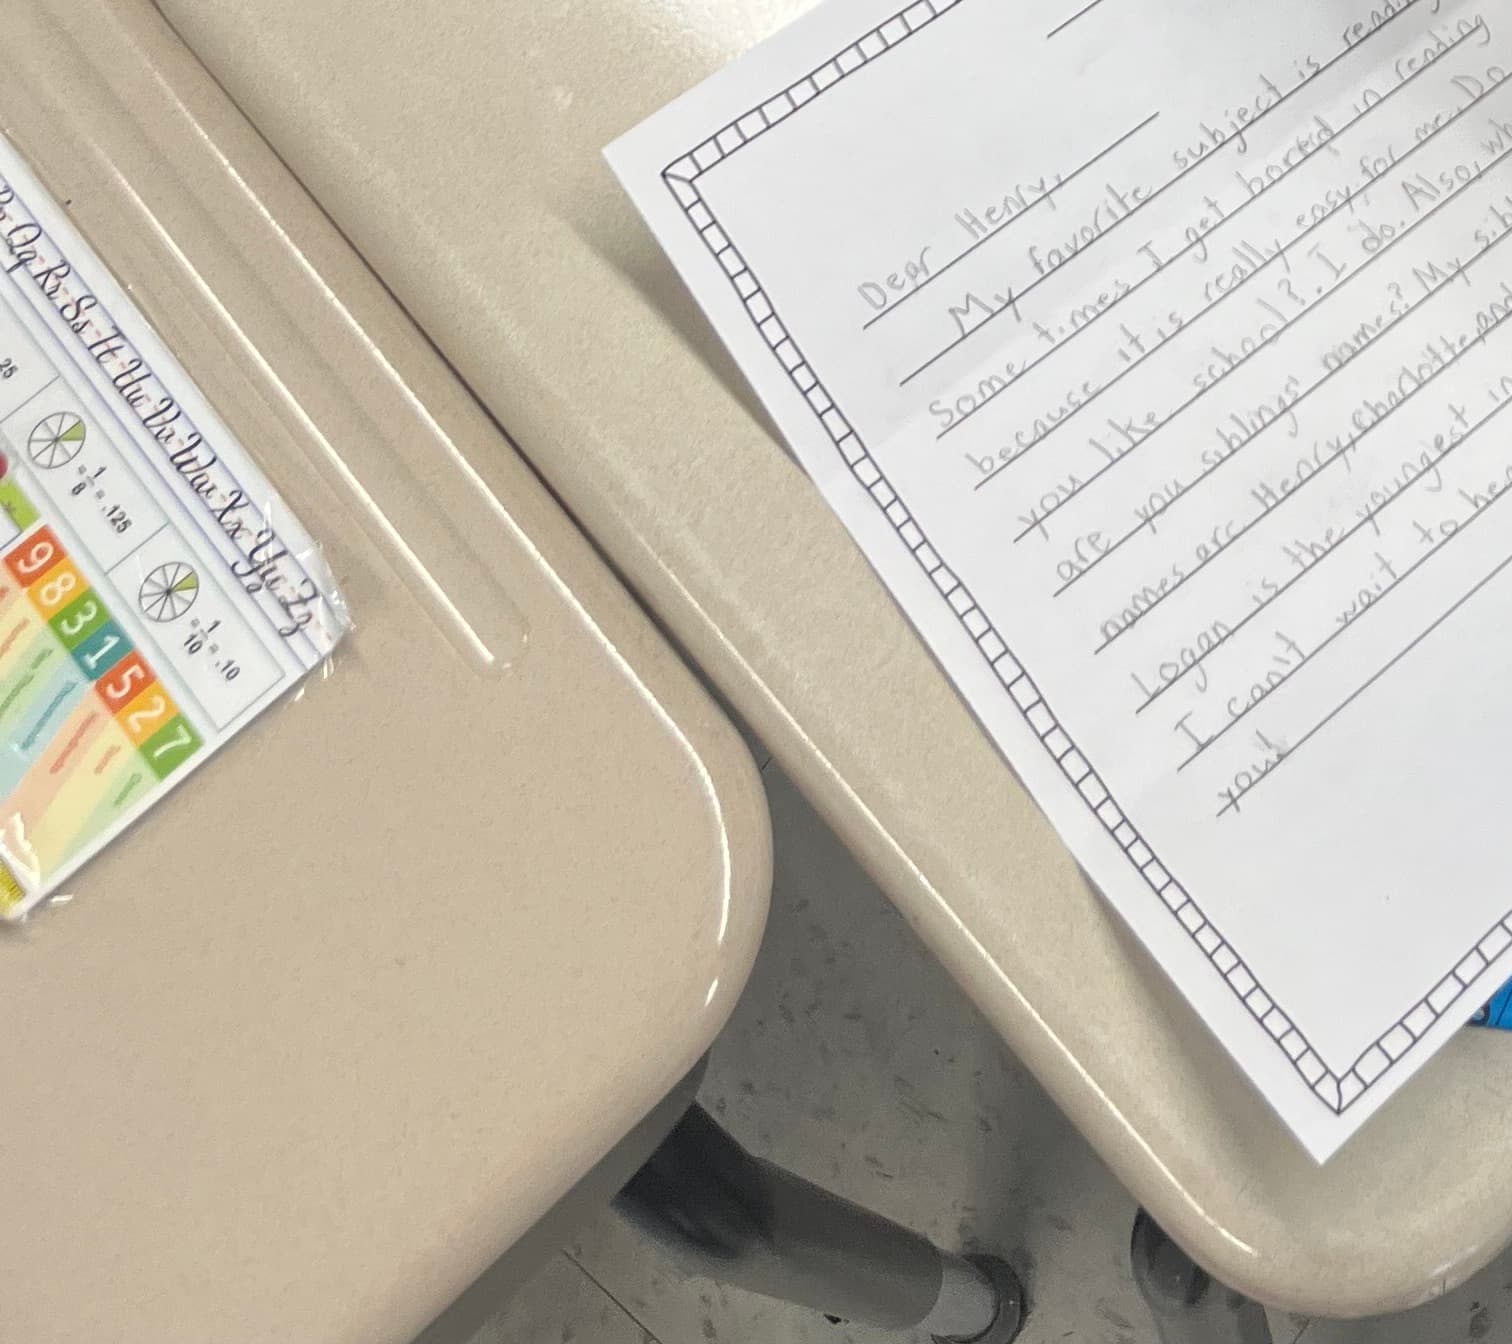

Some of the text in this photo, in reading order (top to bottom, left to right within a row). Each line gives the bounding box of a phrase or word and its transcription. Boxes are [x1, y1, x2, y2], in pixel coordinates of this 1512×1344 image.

[854, 161, 1068, 314] Dear Henry,
[943, 278, 1027, 344] My
[1023, 174, 1155, 278] favorite
[1167, 70, 1289, 179] subject
[1290, 51, 1323, 82] is
[1178, 193, 1232, 264] get
[1349, 85, 1382, 116] in
[1390, 7, 1494, 88] reading
[962, 375, 1100, 479] because
[1111, 320, 1148, 364] it
[1196, 229, 1294, 310] really
[1014, 471, 1090, 545] you
[1085, 403, 1163, 465] like
[1051, 526, 1114, 584] are
[1131, 476, 1190, 536] you
[1409, 249, 1474, 299] My
[1094, 559, 1188, 642] names
[1131, 615, 1239, 708] Logan
[1248, 573, 1281, 606] is
[1279, 519, 1347, 571] the
[1347, 401, 1480, 540] youngest
[1170, 708, 1208, 751] I
[1327, 548, 1402, 627] wait
[1408, 504, 1463, 552] to
